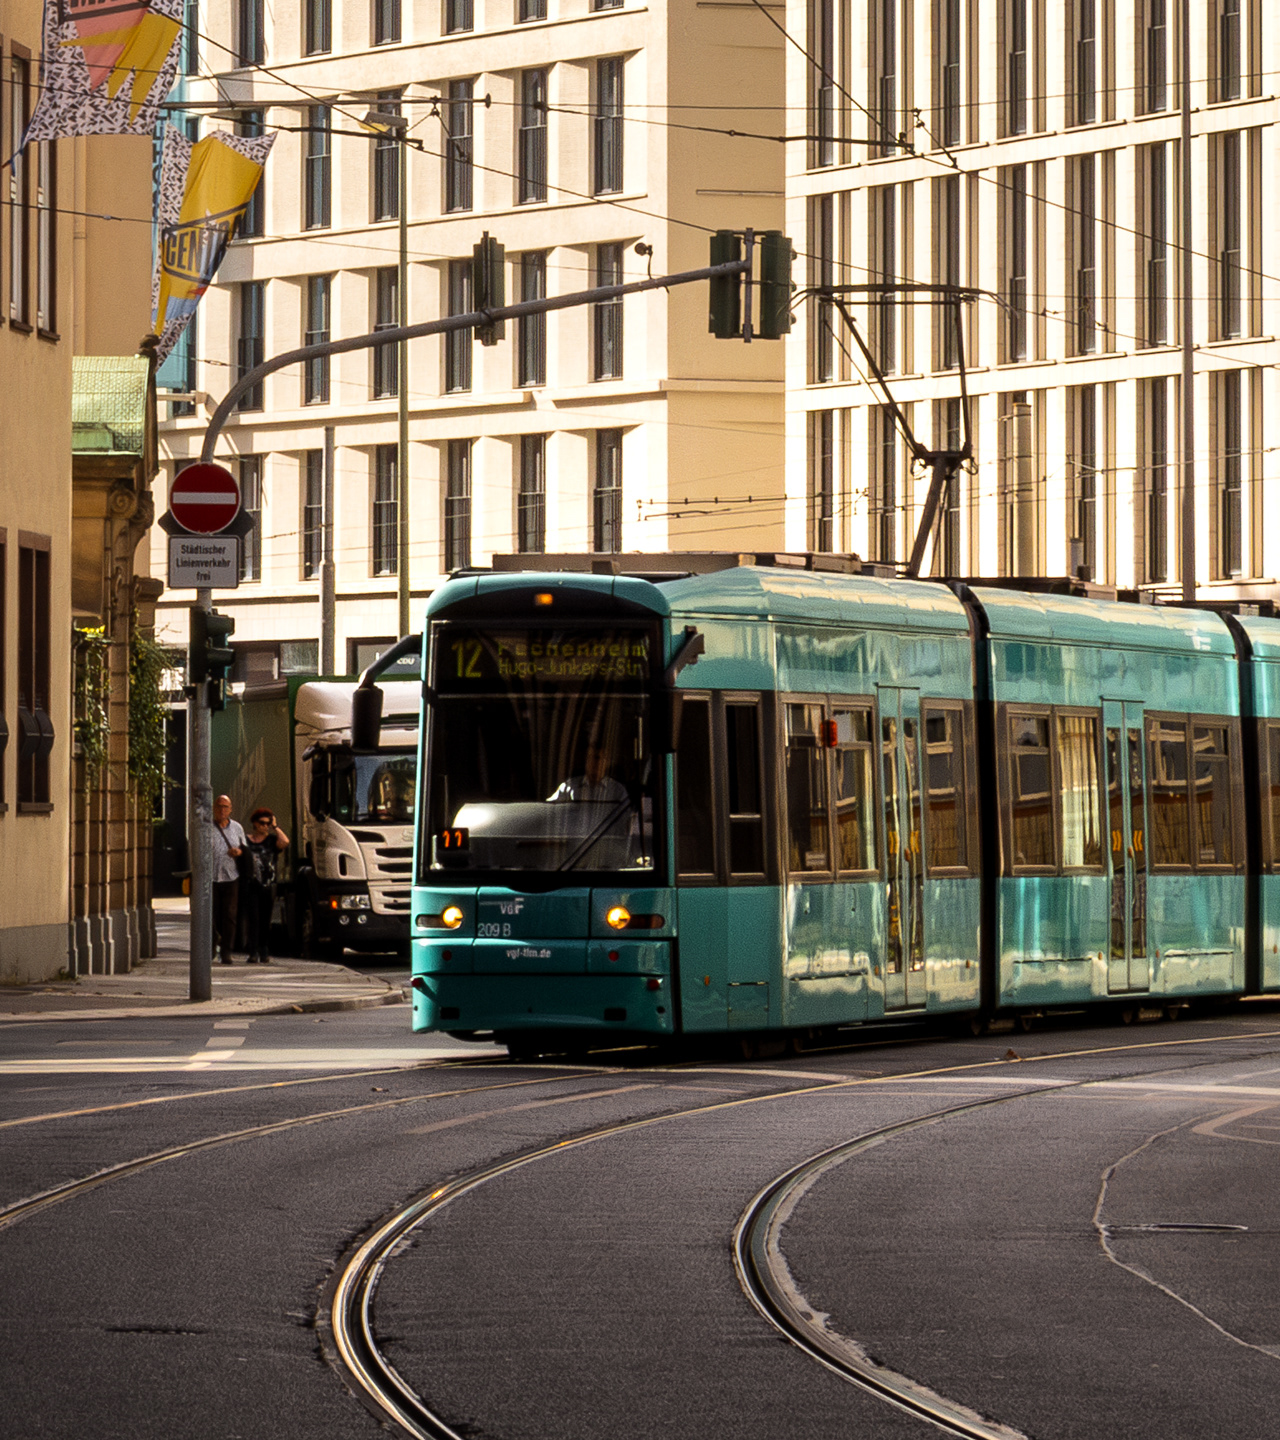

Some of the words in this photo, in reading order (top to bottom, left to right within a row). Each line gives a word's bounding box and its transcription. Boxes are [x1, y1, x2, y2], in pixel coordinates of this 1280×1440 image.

[181, 544, 226, 554] Städtischer
[176, 558, 231, 567] Linienverkehr
[196, 571, 211, 581] frei
[451, 638, 483, 678] 12
[477, 923, 500, 937] 209
[503, 923, 512, 937] B
